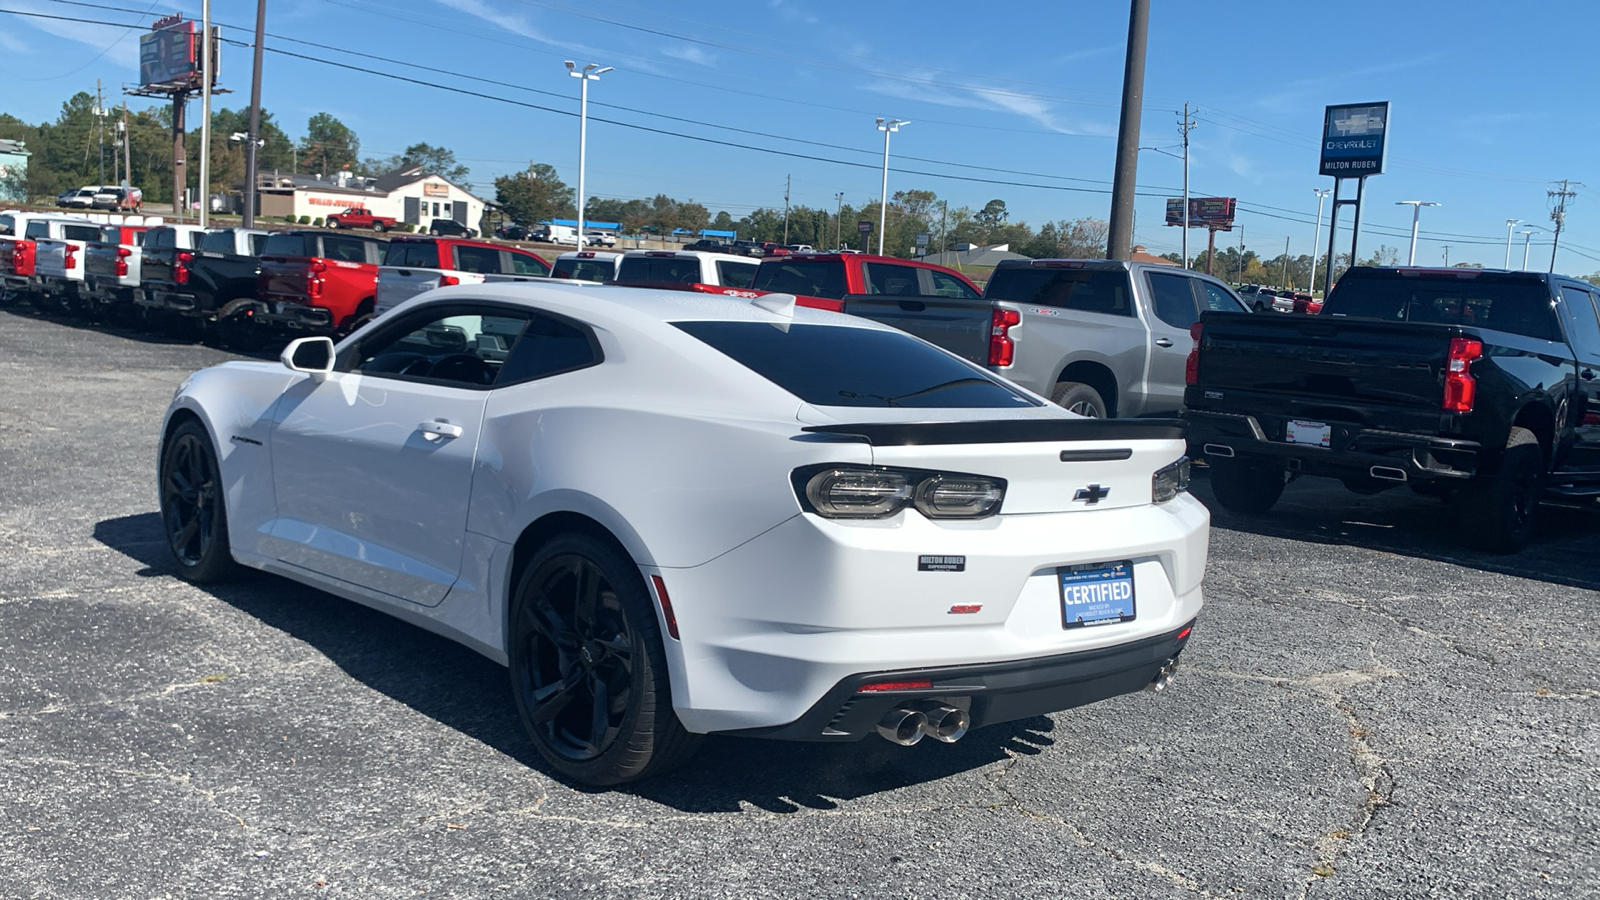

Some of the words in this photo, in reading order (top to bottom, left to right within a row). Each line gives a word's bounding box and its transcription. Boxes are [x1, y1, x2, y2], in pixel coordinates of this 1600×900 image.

[1326, 140, 1377, 149] CHEVROLET
[1325, 161, 1349, 170] MILTON
[1352, 160, 1376, 169] RUBEN
[920, 556, 943, 564] MILTON
[944, 556, 964, 564] RUBEN
[1064, 581, 1131, 605] CERTIFIED
